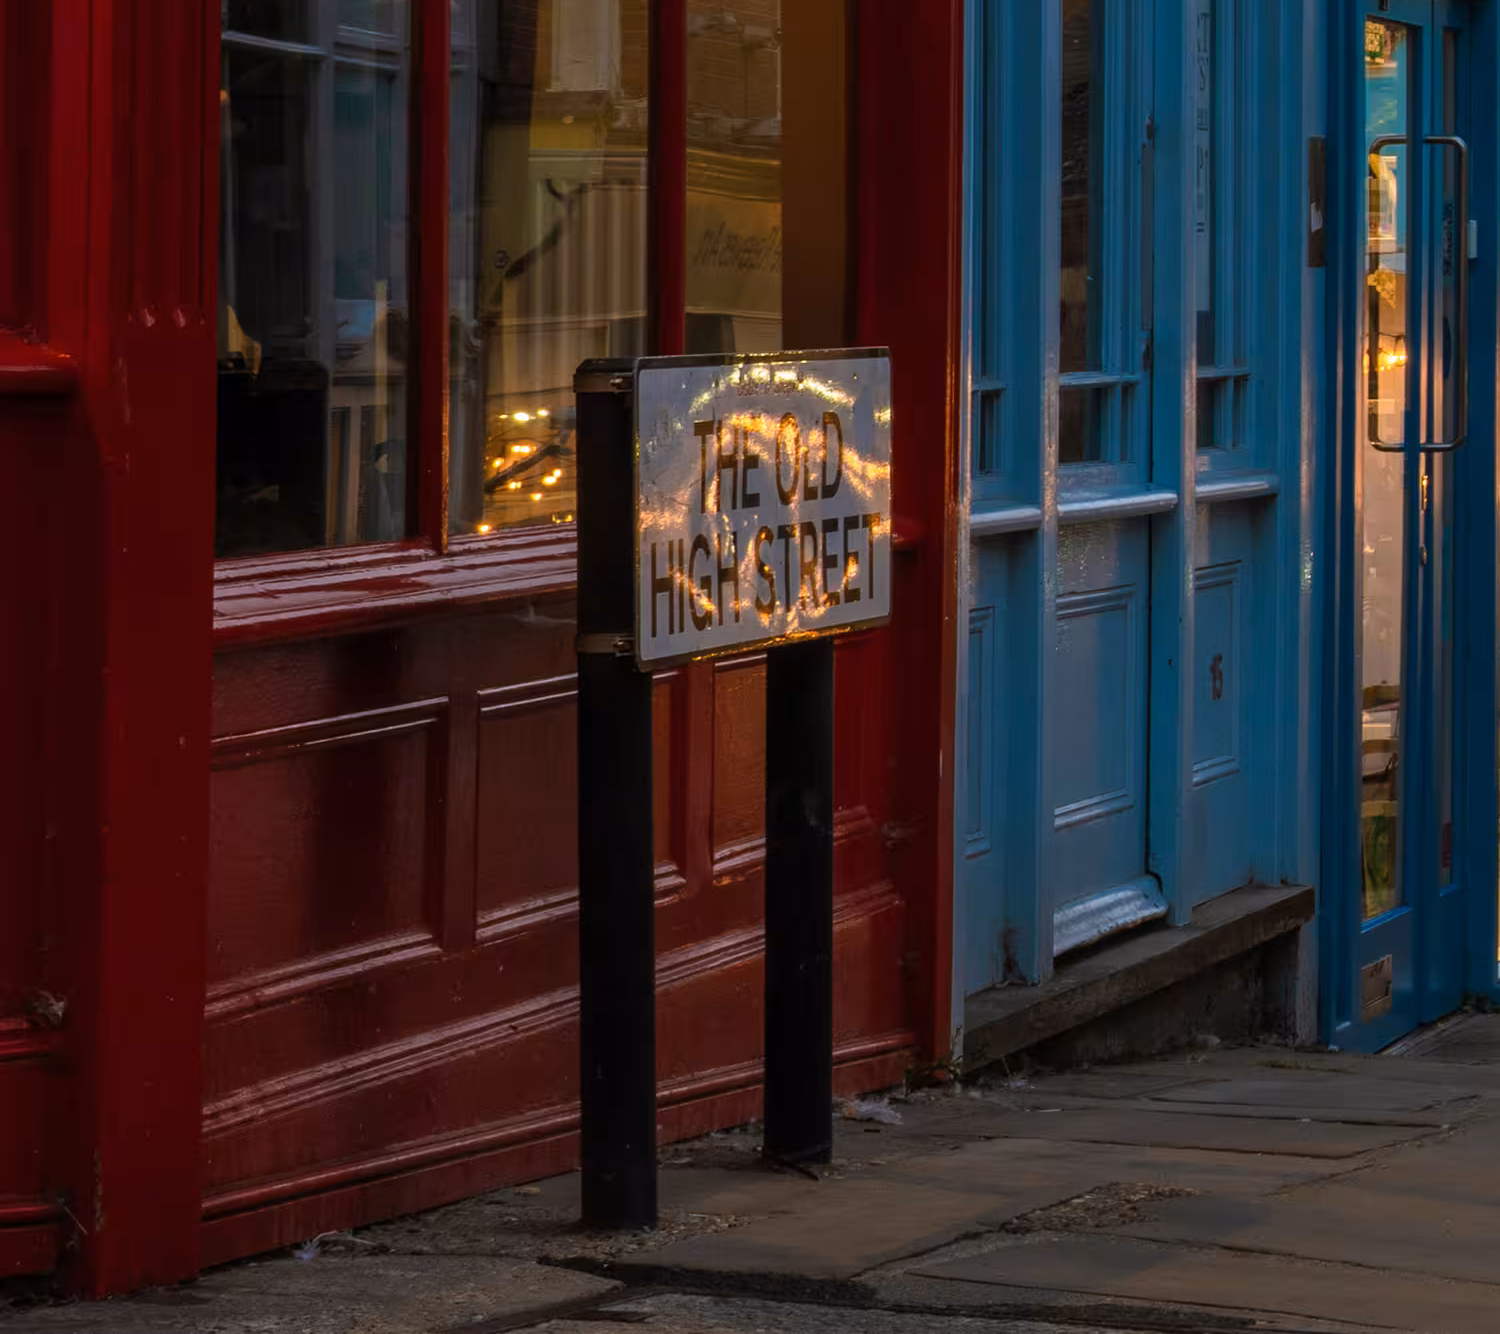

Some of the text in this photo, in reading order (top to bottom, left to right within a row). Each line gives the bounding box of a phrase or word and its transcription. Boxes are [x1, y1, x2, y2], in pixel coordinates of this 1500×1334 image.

[694, 410, 844, 515] THE OLD
[650, 512, 881, 638] HIGH STREET
